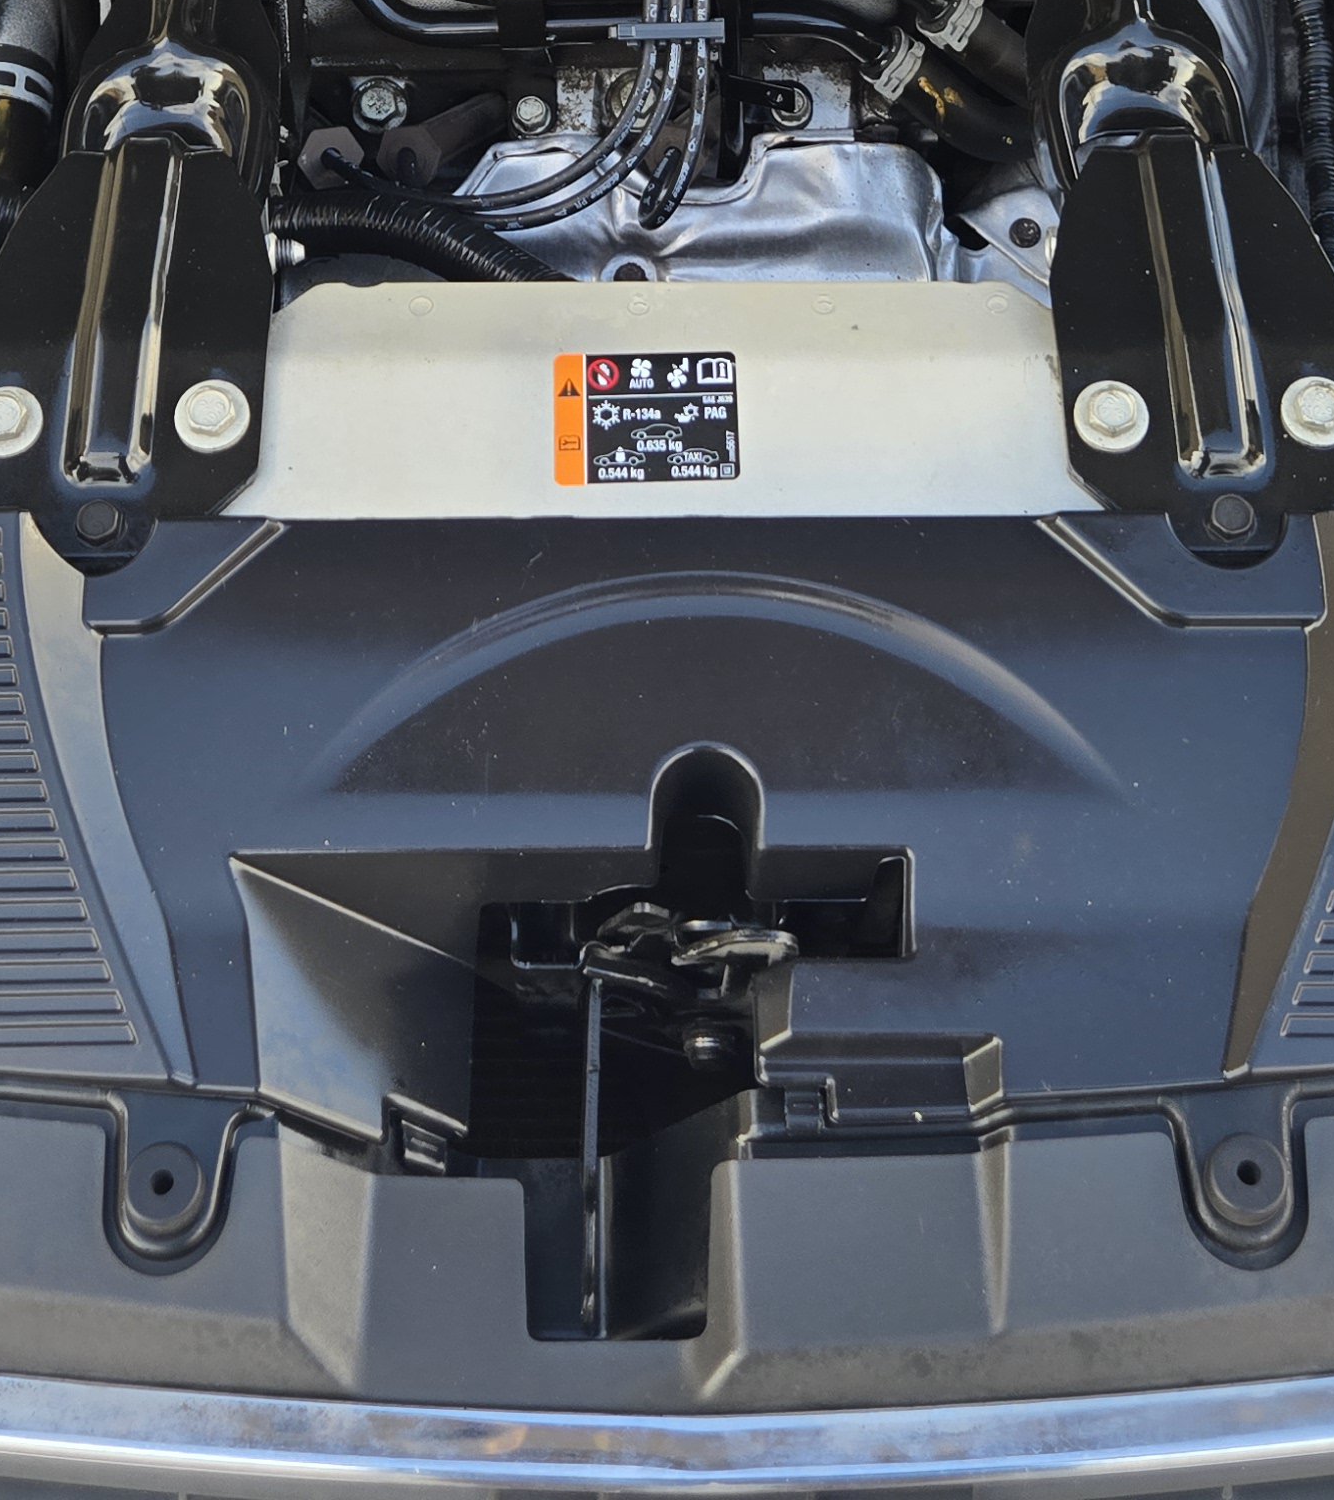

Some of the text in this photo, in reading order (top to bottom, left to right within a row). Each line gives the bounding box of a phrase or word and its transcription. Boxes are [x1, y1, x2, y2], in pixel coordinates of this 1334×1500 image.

[629, 378, 654, 389] AUTO
[622, 408, 662, 420] R-134a
[703, 406, 727, 419] PAG
[636, 439, 683, 452] 0.635 kg
[683, 452, 702, 461] TAXI
[598, 466, 645, 480] 0.544 kg
[671, 465, 701, 478] 0.544
[703, 465, 717, 479] kg
